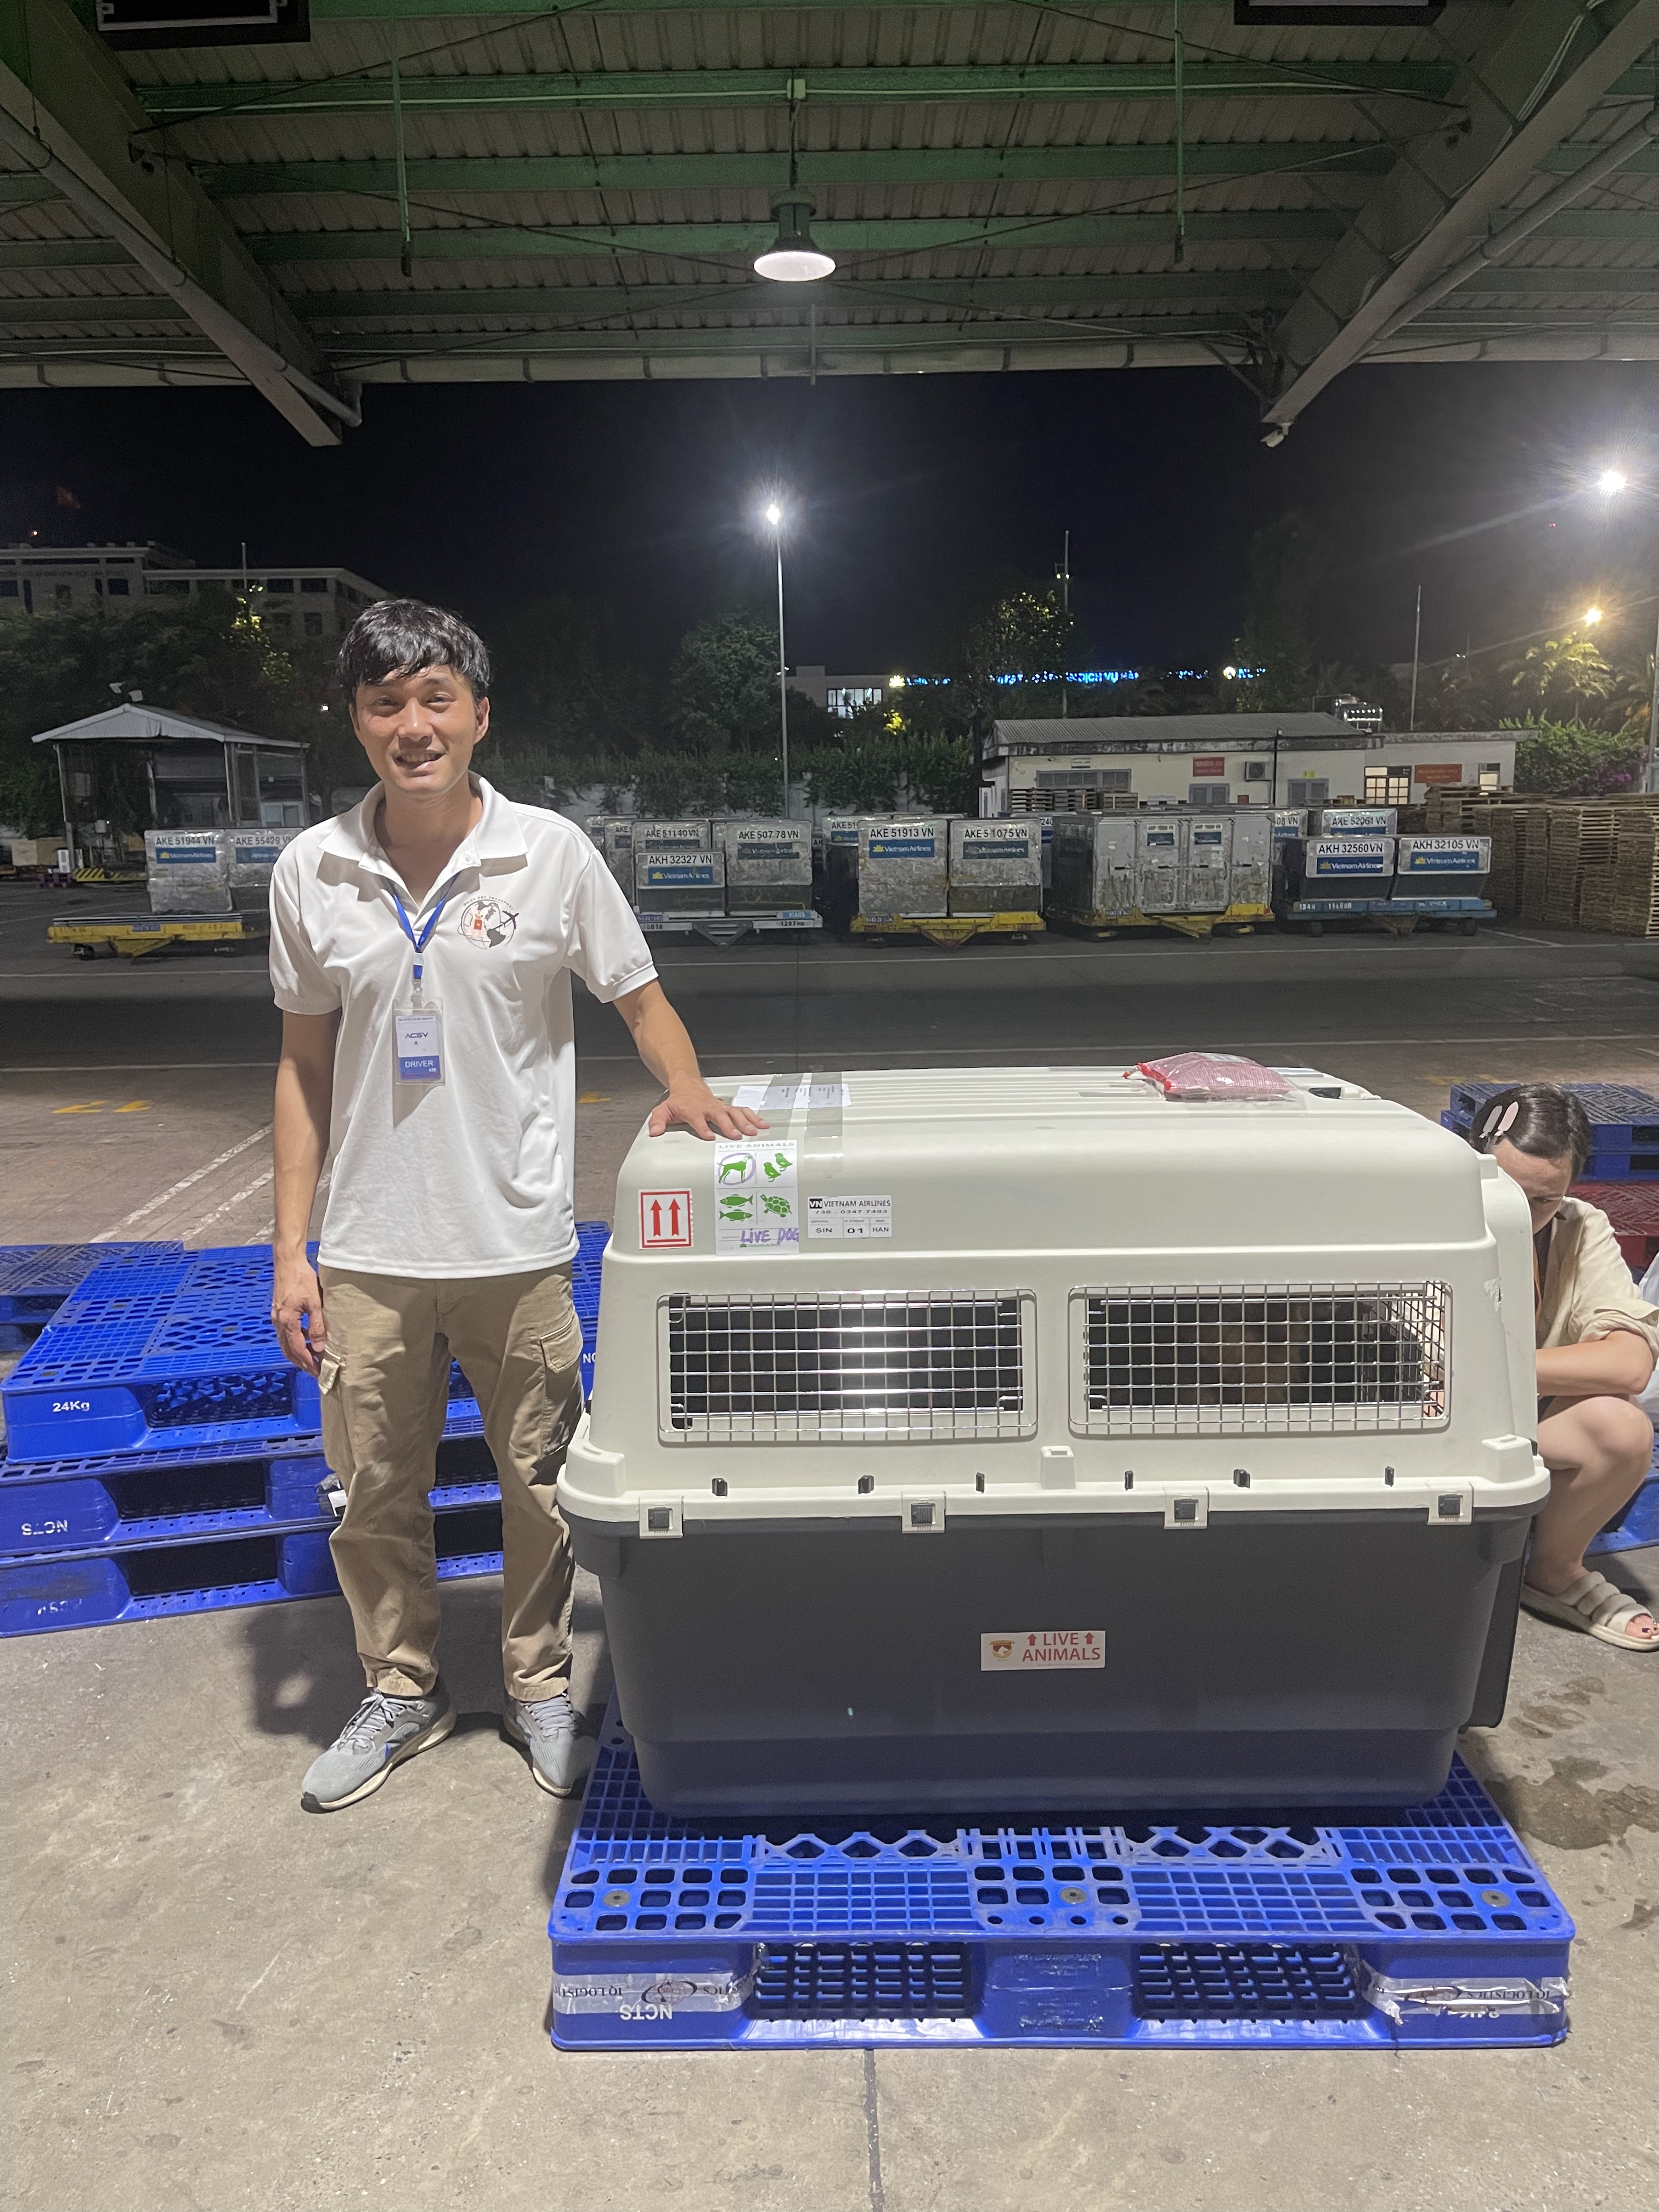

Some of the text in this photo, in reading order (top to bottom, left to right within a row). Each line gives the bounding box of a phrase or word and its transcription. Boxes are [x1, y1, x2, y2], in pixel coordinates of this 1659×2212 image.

[1375, 816, 1386, 825] VN
[738, 831, 755, 839] AKE
[787, 830, 799, 838] VN
[870, 828, 934, 838] AKE 51913 VN
[964, 828, 982, 838] AKE
[1015, 828, 1027, 838] VN
[156, 837, 174, 845] AKE
[203, 836, 215, 844] VN
[1413, 840, 1479, 850] AKH 32105 VN
[1318, 843, 1383, 854] AKH 32560 VN
[649, 855, 712, 865] AKH 32327 VN
[404, 1060, 433, 1068] DRIVER
[53, 1401, 90, 1413] 24Kg
[1043, 1632, 1079, 1646] LIVE
[1022, 1647, 1101, 1662] ANIMALS
[609, 1985, 622, 1996] IQ
[1466, 1990, 1534, 2000] LOGISTICS
[619, 2004, 673, 2021] NCTS
